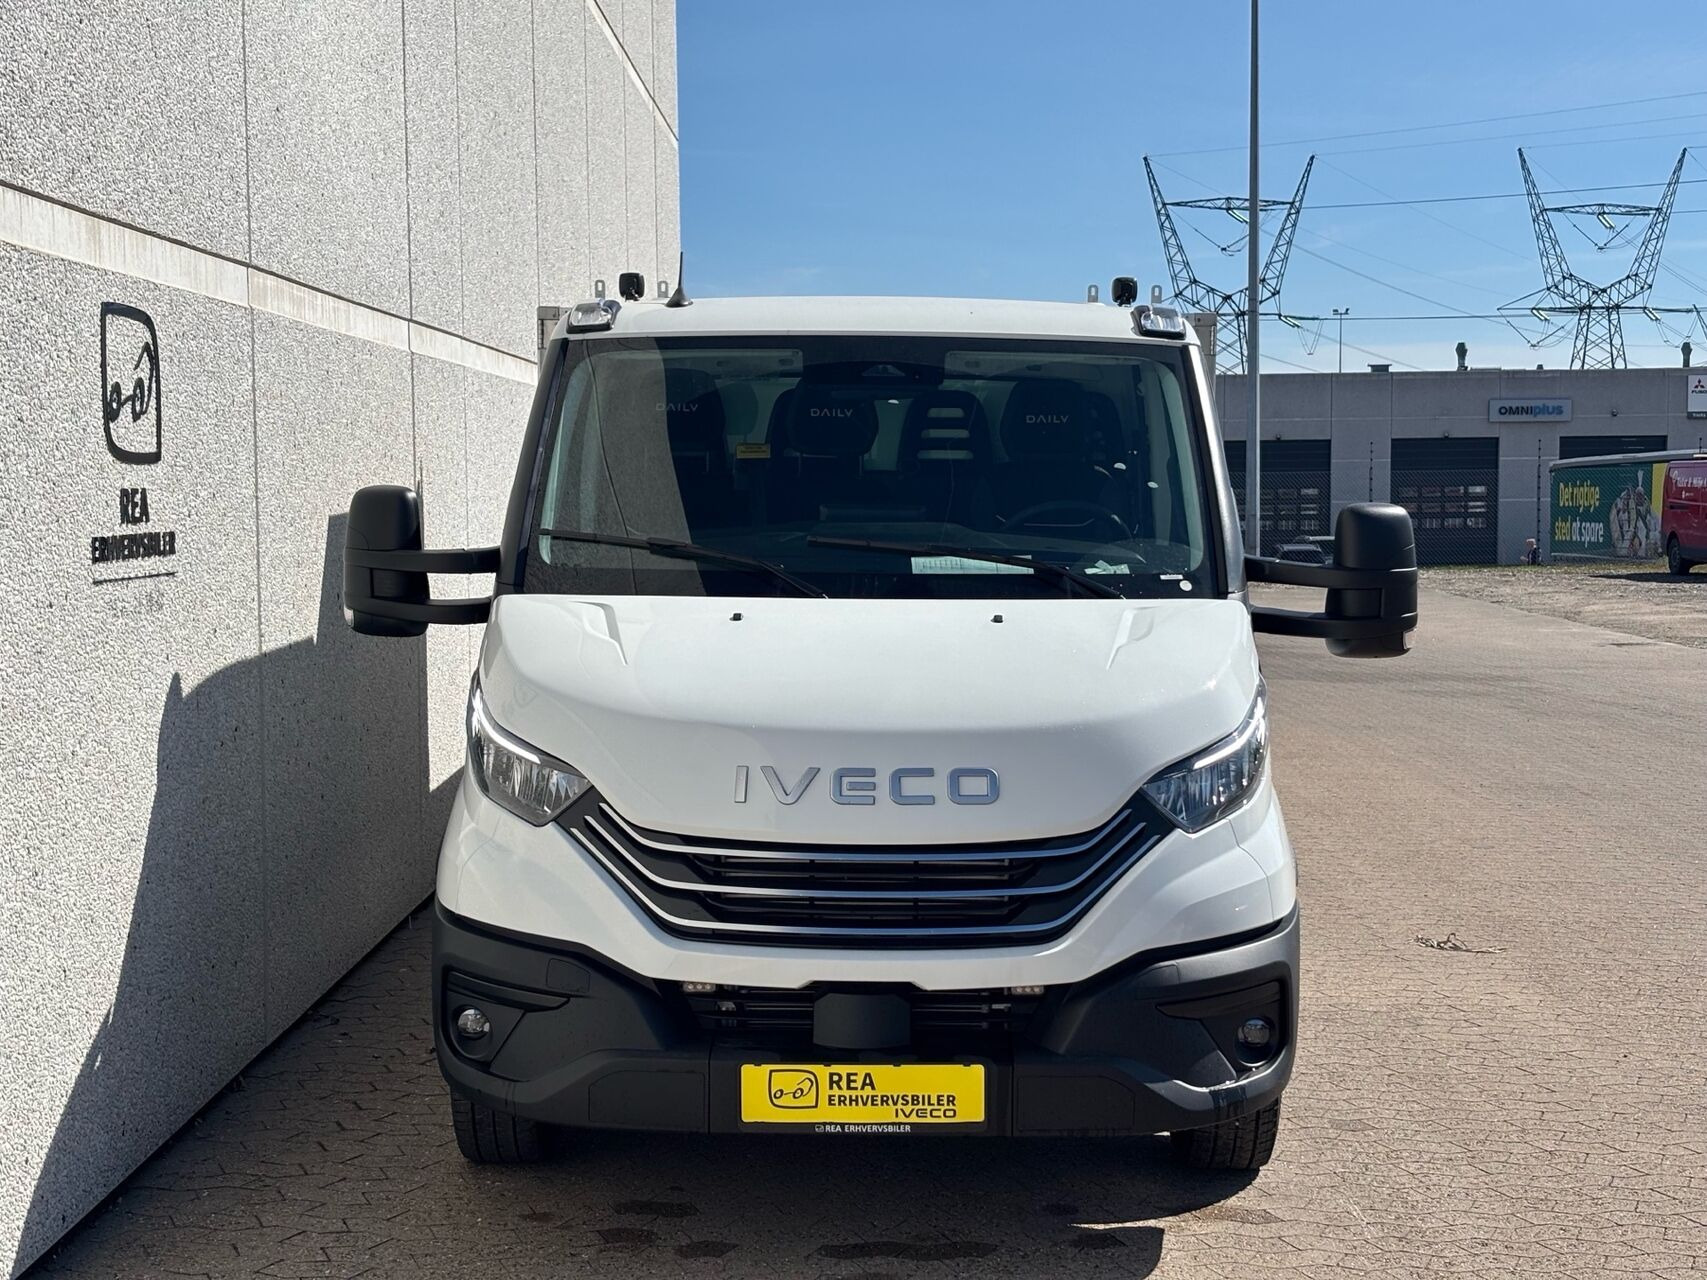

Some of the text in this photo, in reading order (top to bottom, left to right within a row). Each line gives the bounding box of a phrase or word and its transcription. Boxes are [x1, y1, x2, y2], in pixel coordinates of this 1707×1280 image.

[656, 403, 698, 412] DAILY
[810, 408, 853, 417] DAILY
[1498, 402, 1564, 417] OMNIplus
[1026, 415, 1069, 423] DAILY
[1559, 480, 1600, 512] Det rigtige
[119, 488, 150, 525] REA
[1555, 517, 1604, 548] sted at spare
[91, 531, 177, 564] ERHVERVSBILER
[733, 764, 1001, 806] IVECO
[829, 1073, 876, 1090] REA
[828, 1095, 956, 1106] ERHVERVSBILER
[895, 1109, 956, 1118] IVECO
[825, 1124, 911, 1133] REA ERHVERVSBILER
